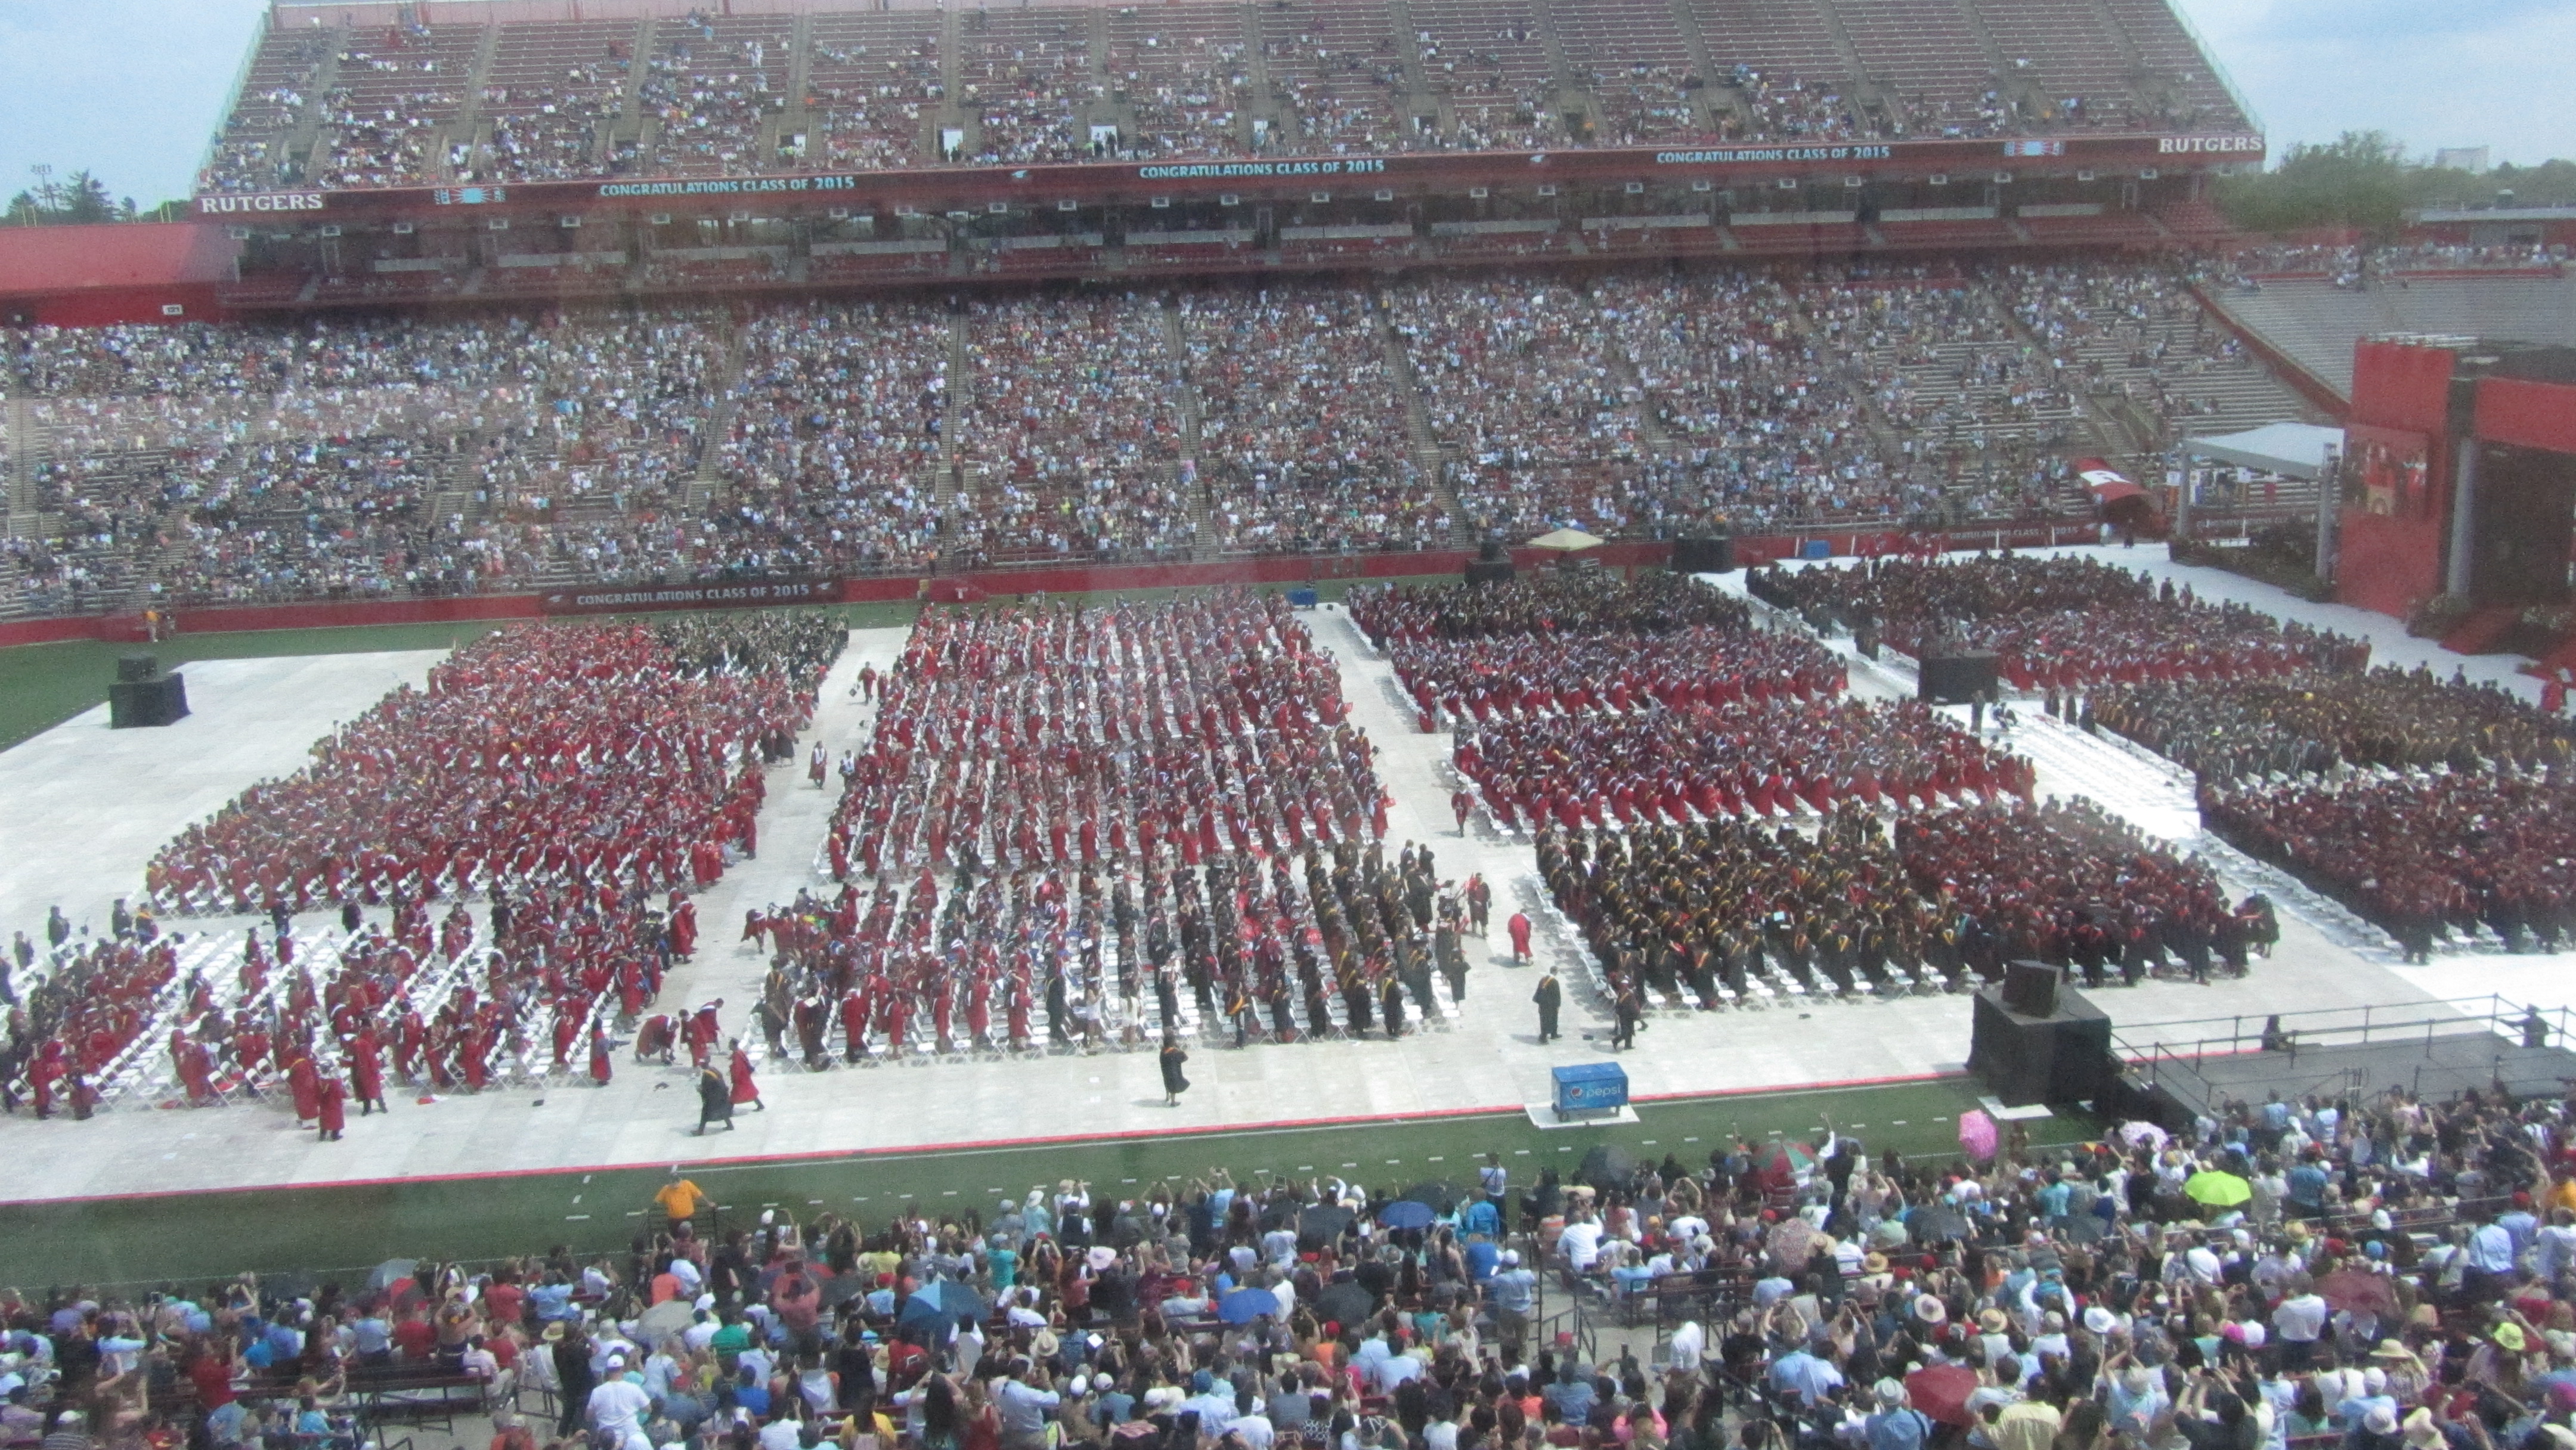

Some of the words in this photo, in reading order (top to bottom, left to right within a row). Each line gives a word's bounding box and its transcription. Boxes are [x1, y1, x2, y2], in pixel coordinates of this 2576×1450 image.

[2159, 137, 2262, 152] RUTGERS
[1657, 151, 1783, 163] CONGRATULATIONS
[1787, 148, 1827, 160] CLASS
[1831, 148, 1848, 159] OF
[1854, 146, 1889, 159] 2015
[1140, 164, 1272, 178] CONGRATULATIONS
[1277, 162, 1318, 173] CLASS
[1323, 162, 1340, 173] OF
[1346, 160, 1384, 172] 2015
[600, 182, 738, 196] CONGRATULATIONS
[742, 179, 785, 191] CLASS
[790, 179, 808, 190] OF
[815, 176, 854, 190] 2015
[202, 194, 323, 213] RUTGERS
[577, 590, 703, 605] CONGRATULATIONS
[707, 588, 746, 600] CLASS
[750, 587, 767, 597] OF
[772, 584, 810, 597] 2015
[1586, 1084, 1621, 1098] pepsi
